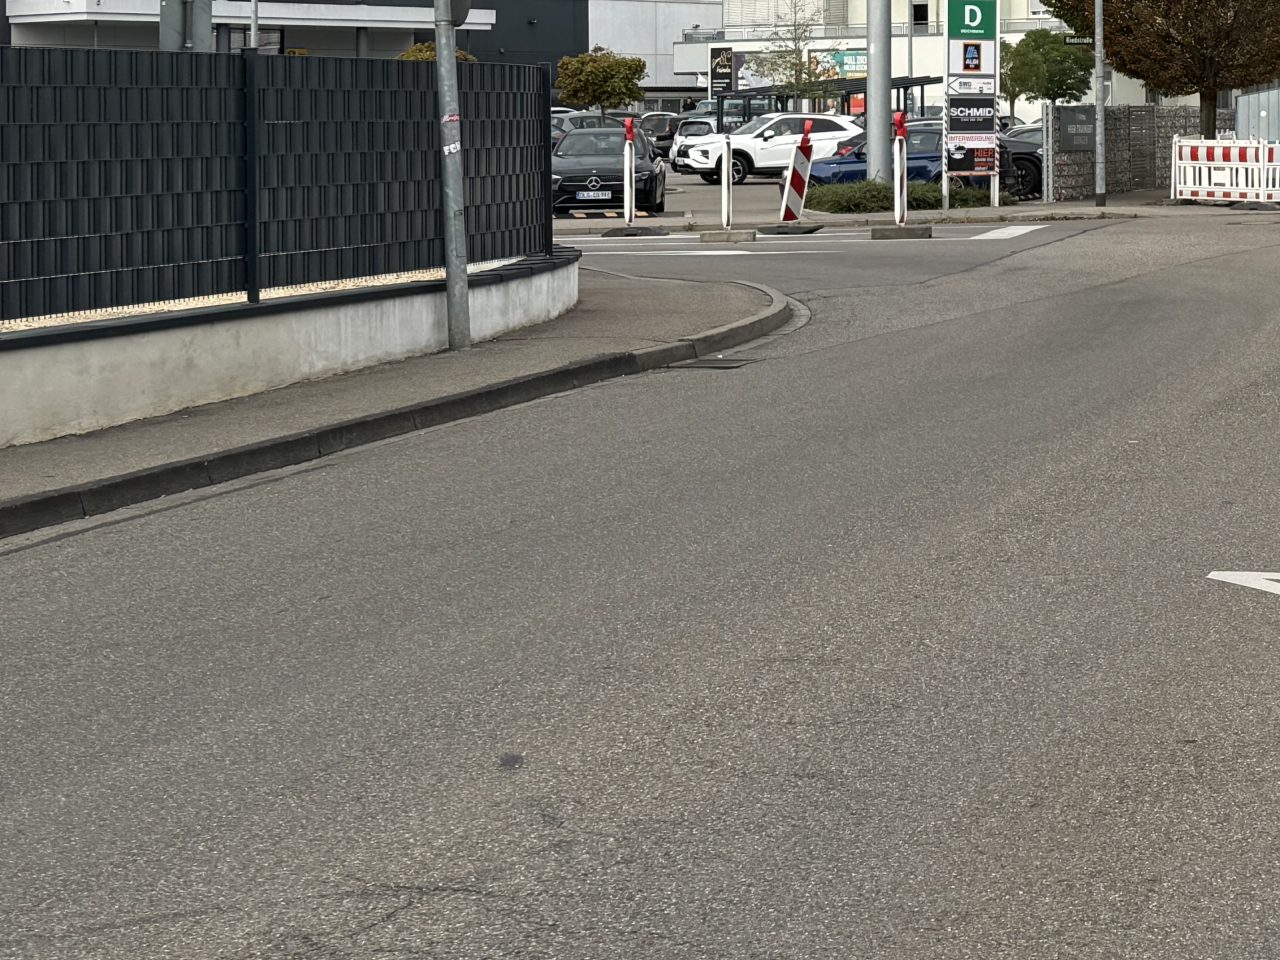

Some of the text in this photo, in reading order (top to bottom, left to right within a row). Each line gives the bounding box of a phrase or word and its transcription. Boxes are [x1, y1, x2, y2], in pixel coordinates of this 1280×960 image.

[964, 4, 982, 27] D
[950, 107, 994, 116] SCHMID
[974, 148, 993, 157] HIER
